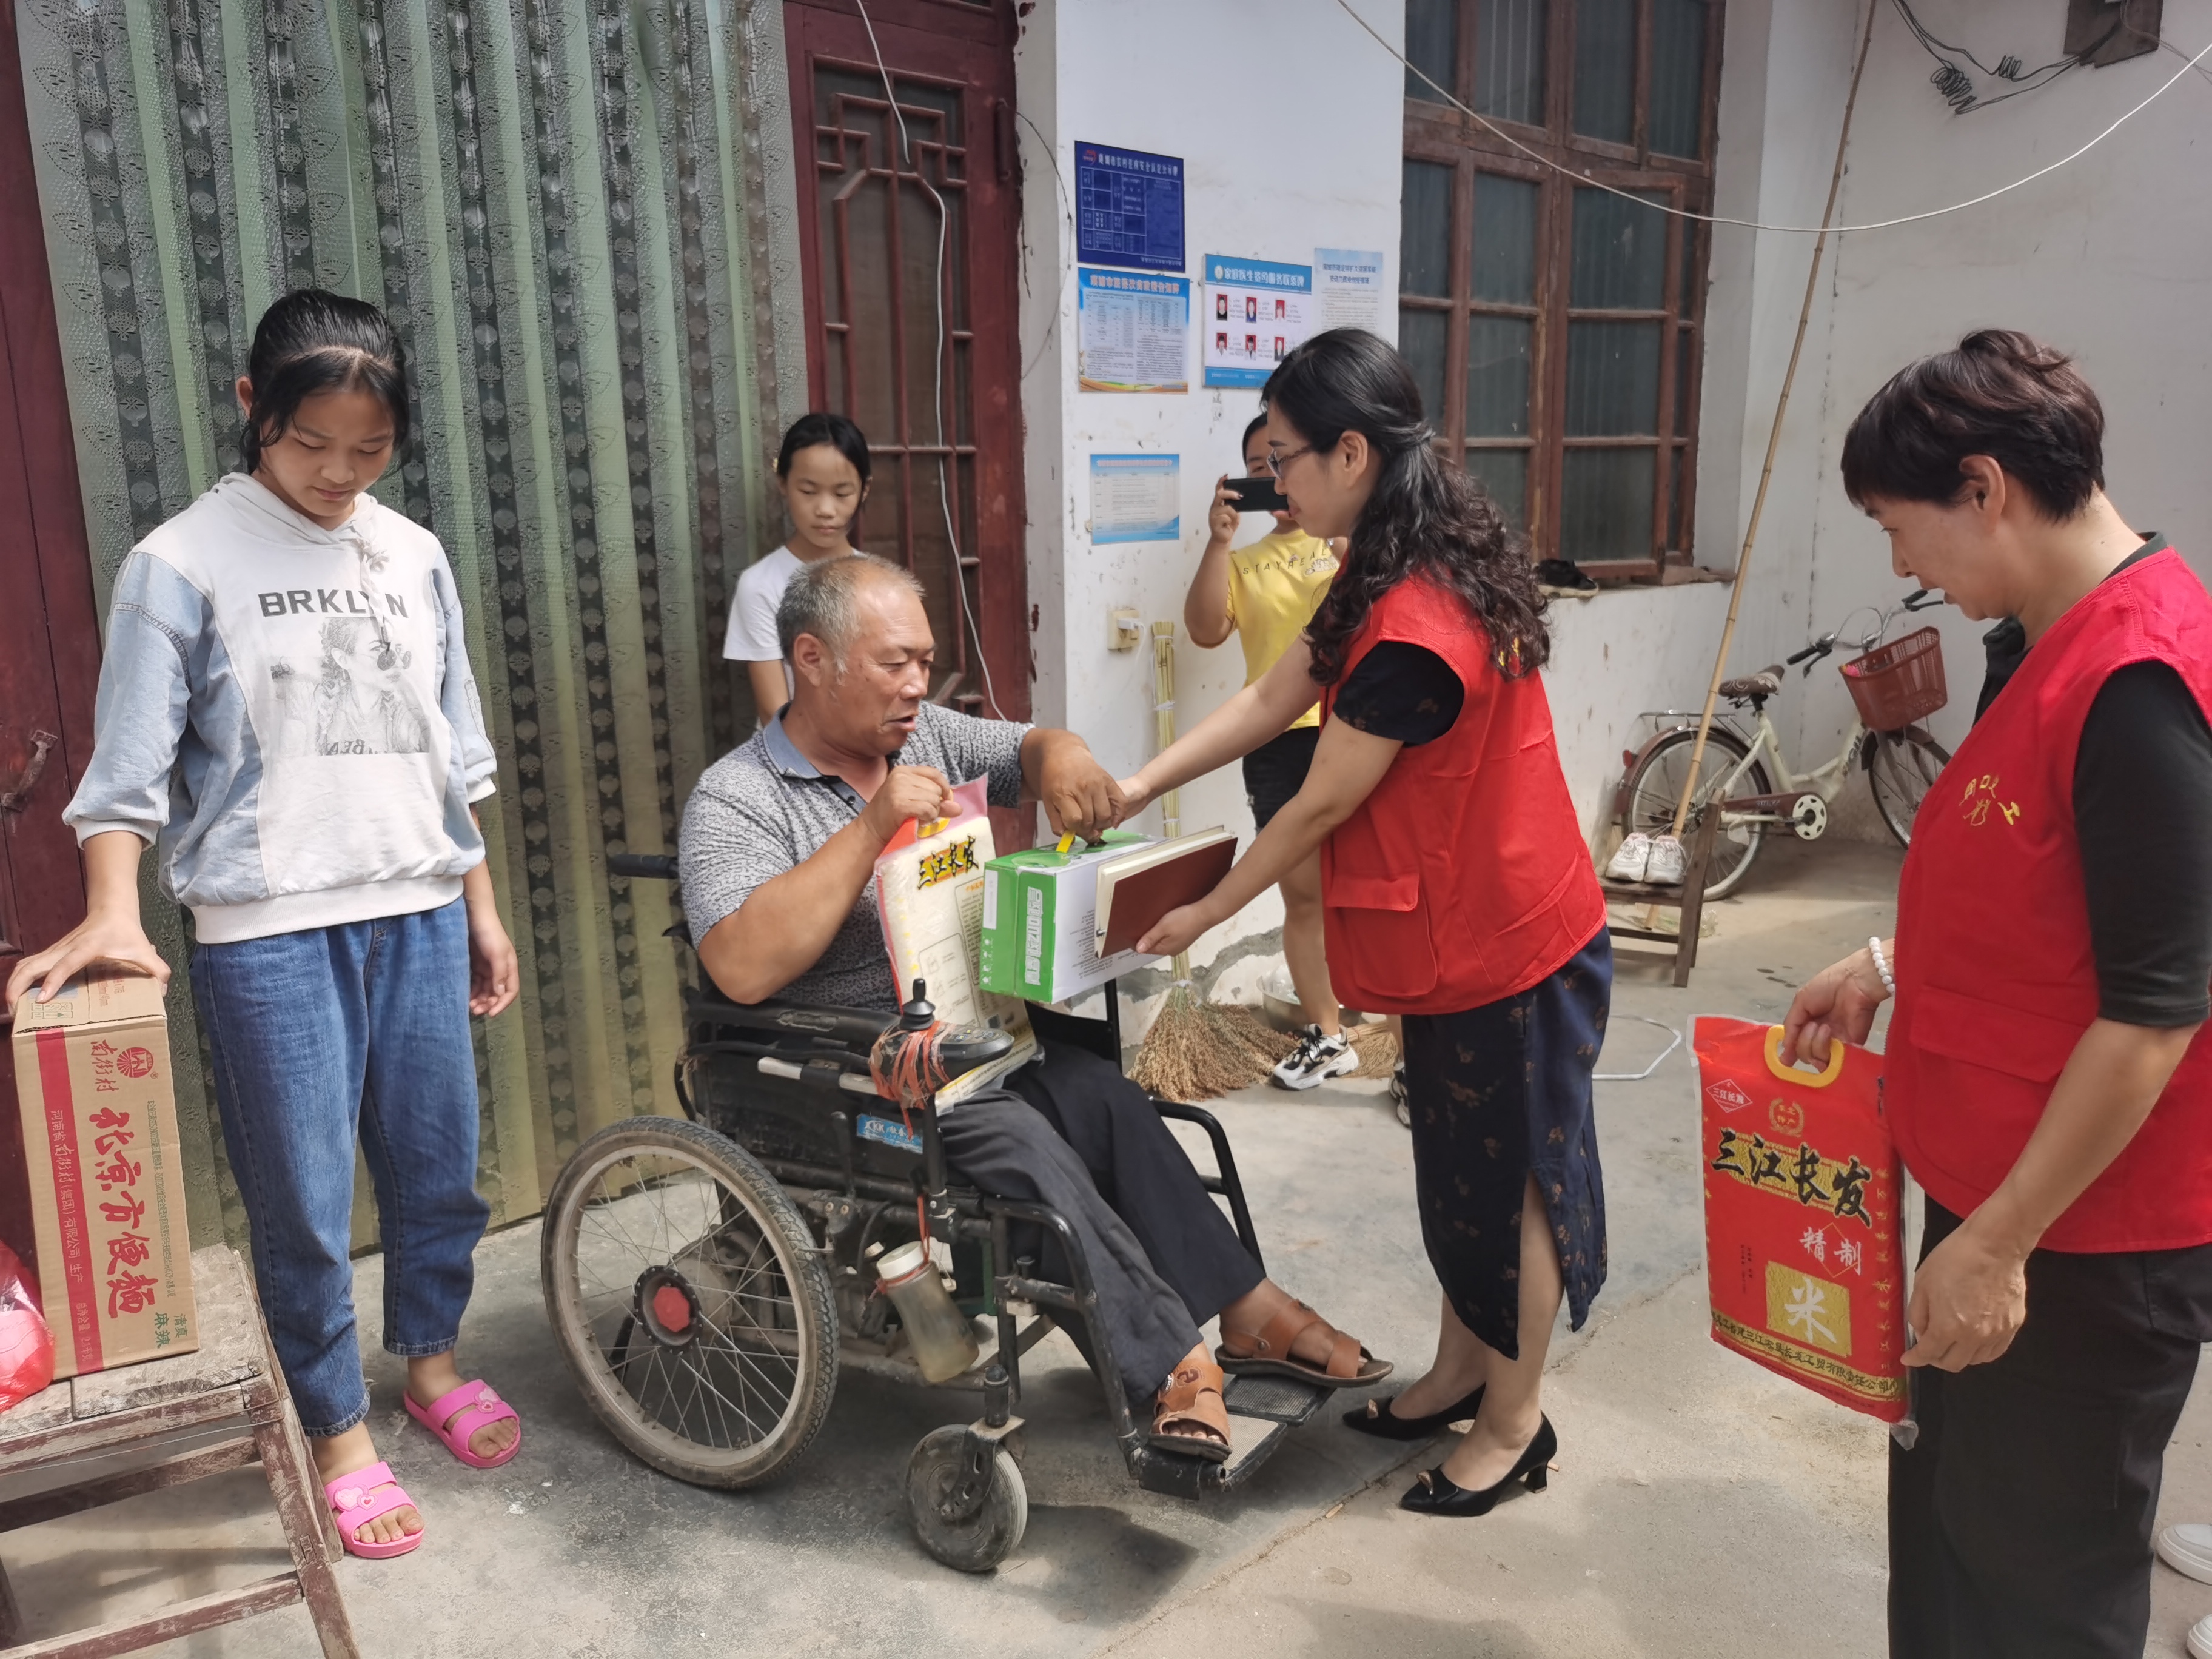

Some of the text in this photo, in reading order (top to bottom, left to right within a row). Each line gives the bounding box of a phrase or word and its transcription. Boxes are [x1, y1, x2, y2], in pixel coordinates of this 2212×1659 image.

[90, 1039, 119, 1093] 南街村
[1709, 1126, 1873, 1230] 三江长发
[68, 1263, 84, 1283] 生产
[1798, 1225, 1862, 1276] 精制
[153, 1312, 170, 1348] 麻辣
[173, 1313, 188, 1338] 清真
[1783, 1277, 1838, 1344] 米
